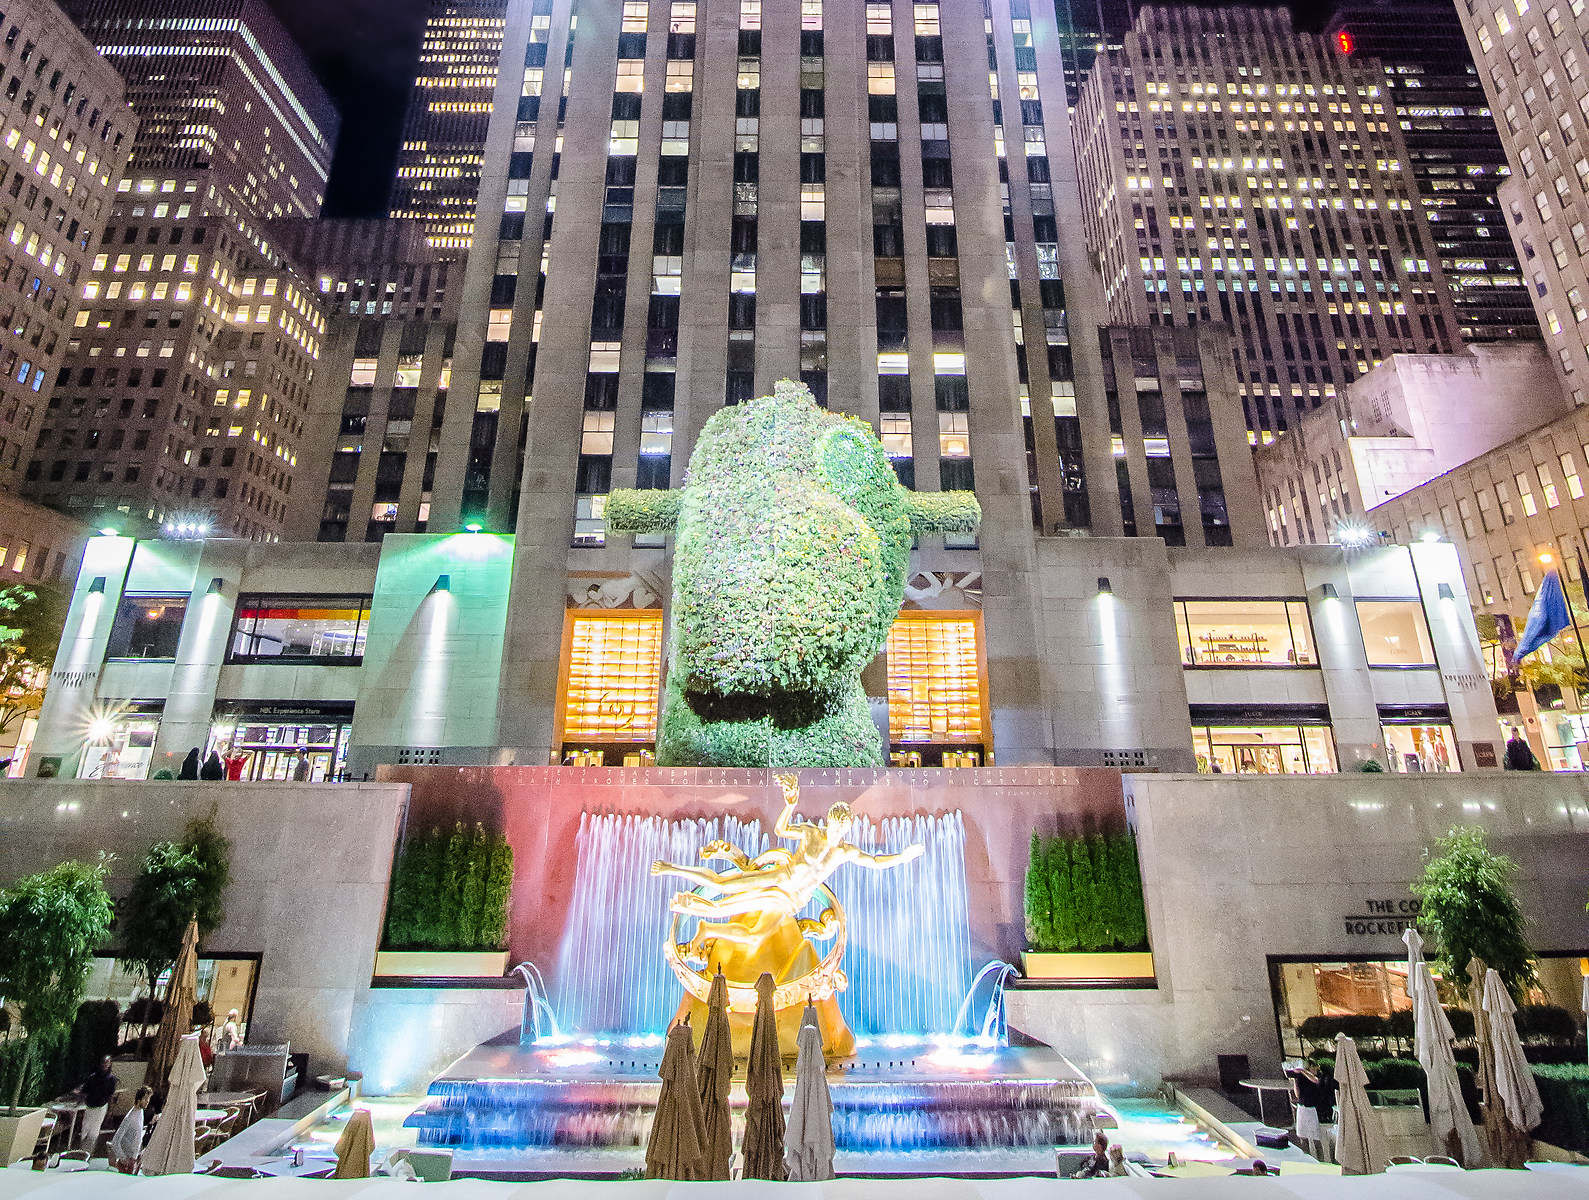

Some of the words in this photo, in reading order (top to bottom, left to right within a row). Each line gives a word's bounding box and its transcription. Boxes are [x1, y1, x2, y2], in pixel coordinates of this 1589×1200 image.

[607, 769, 688, 777] TEACHER
[1366, 900, 1394, 913] THE
[1399, 900, 1421, 913] CO
